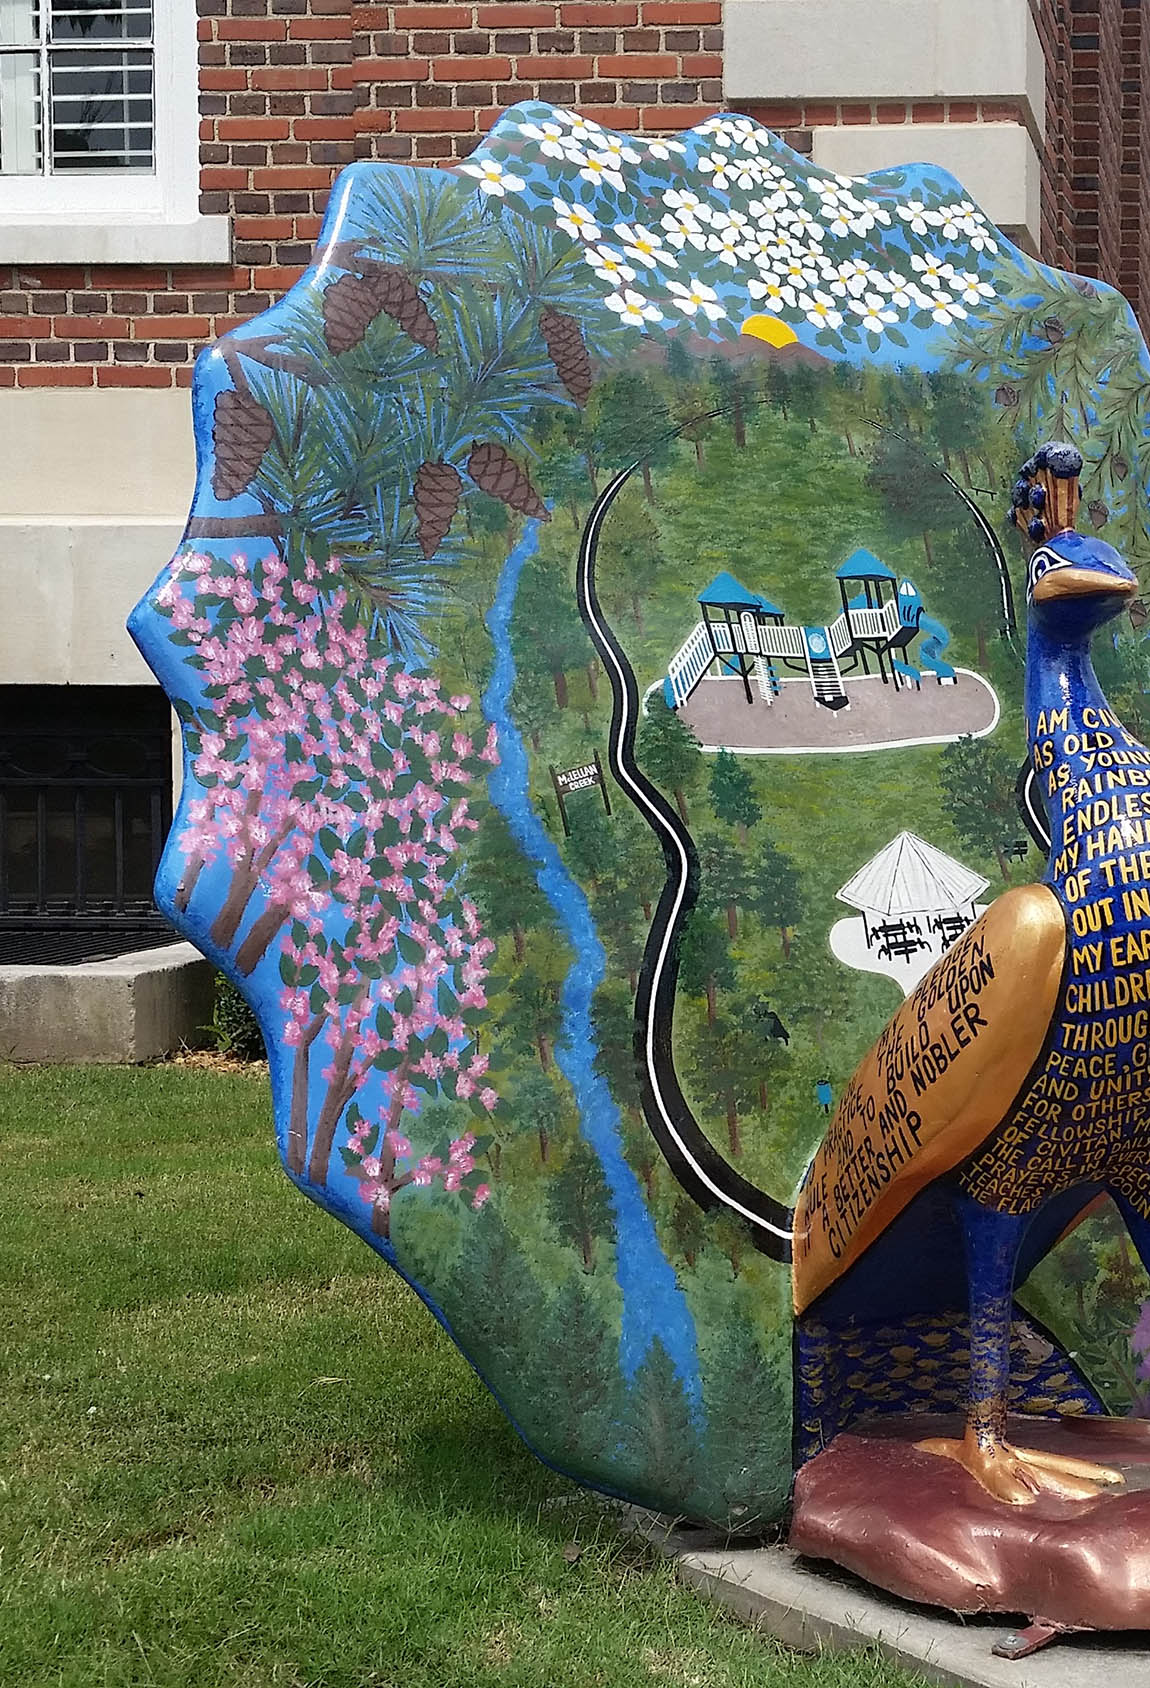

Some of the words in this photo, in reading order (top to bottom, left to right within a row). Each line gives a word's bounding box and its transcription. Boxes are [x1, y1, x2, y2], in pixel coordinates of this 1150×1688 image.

[1036, 707, 1068, 737] AM
[1082, 707, 1121, 729] CIV
[1033, 740, 1054, 772] AS
[1063, 731, 1114, 755] OLD
[569, 776, 596, 791] CREEK
[1048, 762, 1070, 797] AS
[1053, 841, 1079, 881] MY
[1065, 869, 1091, 903] OF
[1073, 898, 1114, 937] OUT
[1124, 889, 1150, 921] IN
[1073, 942, 1103, 976] MY
[878, 1024, 904, 1077] THE
[918, 935, 985, 1022] GOLDEN
[836, 1129, 854, 1177] AND
[860, 1095, 875, 1131] TO
[886, 1021, 931, 1096] BUILD
[947, 952, 995, 1015] UPON
[1032, 1073, 1079, 1102] AND
[822, 1203, 830, 1232] A
[833, 1135, 876, 1214] BETTER
[878, 1089, 908, 1140] AND
[909, 1002, 988, 1097] NOBLER
[1012, 1106, 1146, 1141] FELLOWSHIP
[1022, 1091, 1062, 1123] FOR
[992, 1137, 1024, 1166] THE
[1027, 1156, 1077, 1171] CALL
[1082, 1148, 1106, 1163] TO
[1003, 1126, 1030, 1146] OF
[1037, 1126, 1127, 1158] CIVITAN.
[829, 1110, 923, 1258] CITIZENSHIP
[970, 1161, 1045, 1199] TEACHES
[979, 1153, 1071, 1184] PRAYERS
[1080, 1160, 1100, 1175] IN
[960, 1171, 992, 1204] THE
